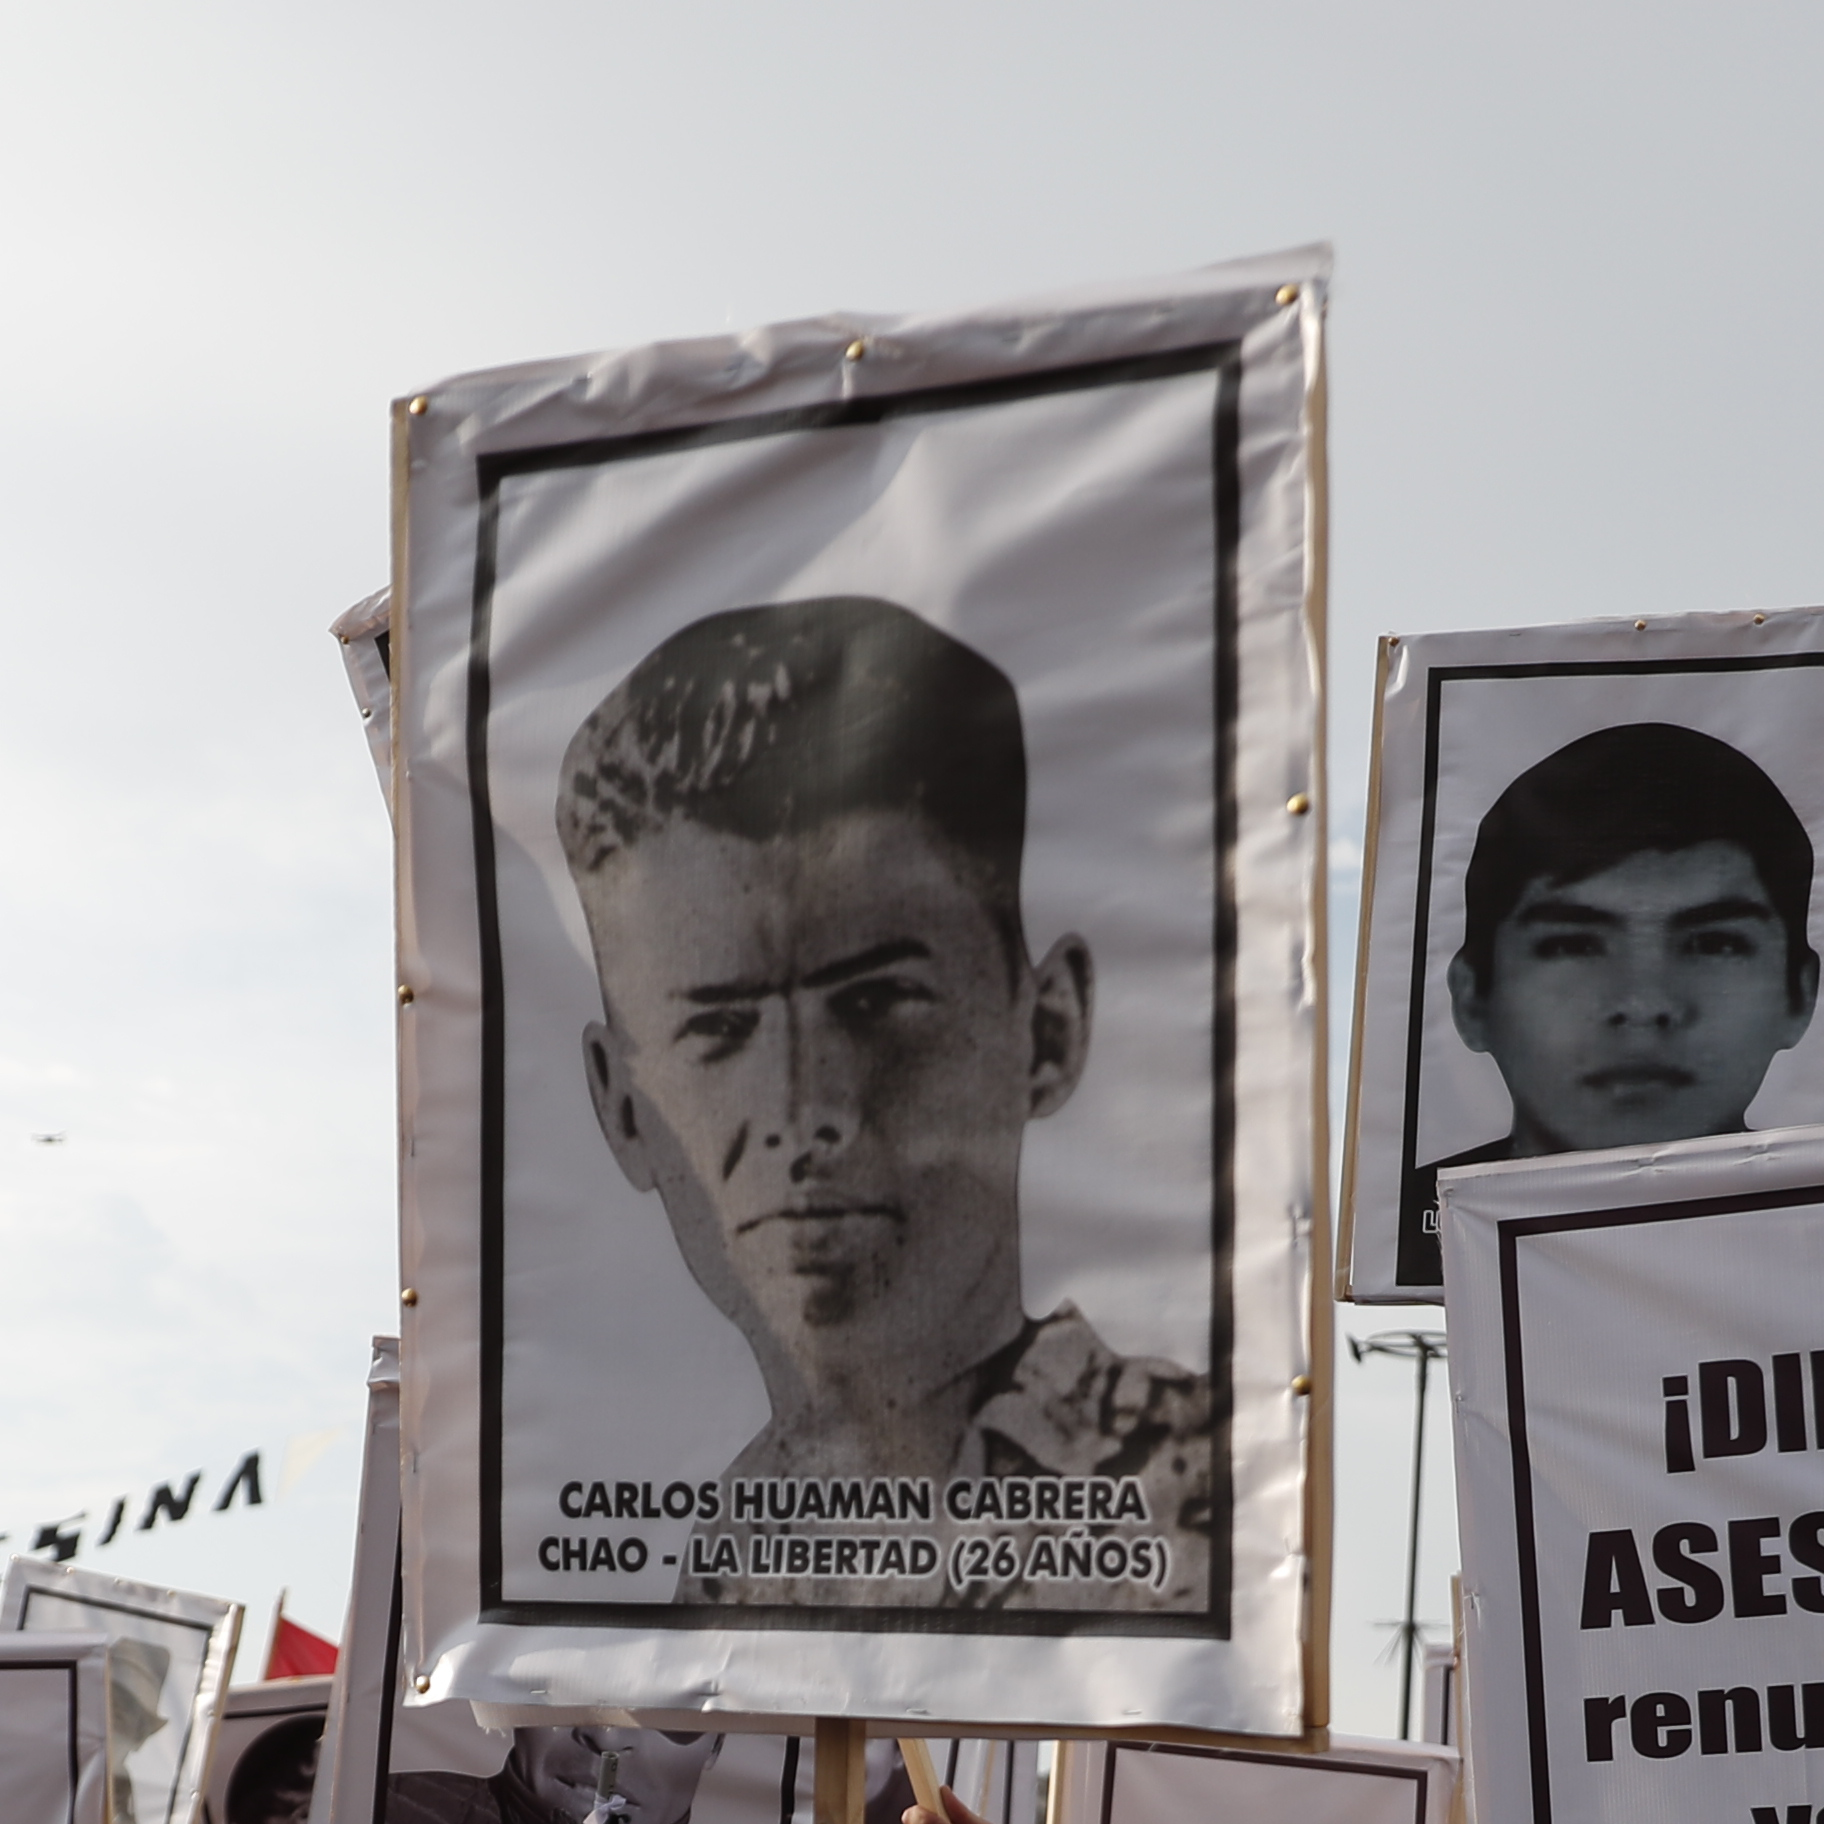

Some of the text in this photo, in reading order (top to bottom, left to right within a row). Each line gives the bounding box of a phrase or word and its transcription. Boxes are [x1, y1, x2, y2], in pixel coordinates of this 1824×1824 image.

[559, 1476, 1150, 1523] CARLOS HUAMAN CABRERA
[538, 1540, 649, 1574] CHAO
[691, 1538, 740, 1577] LA
[749, 1537, 938, 1580] LIBERTAD
[950, 1538, 1016, 1587] (26
[1026, 1528, 1169, 1590] AÑOS)
